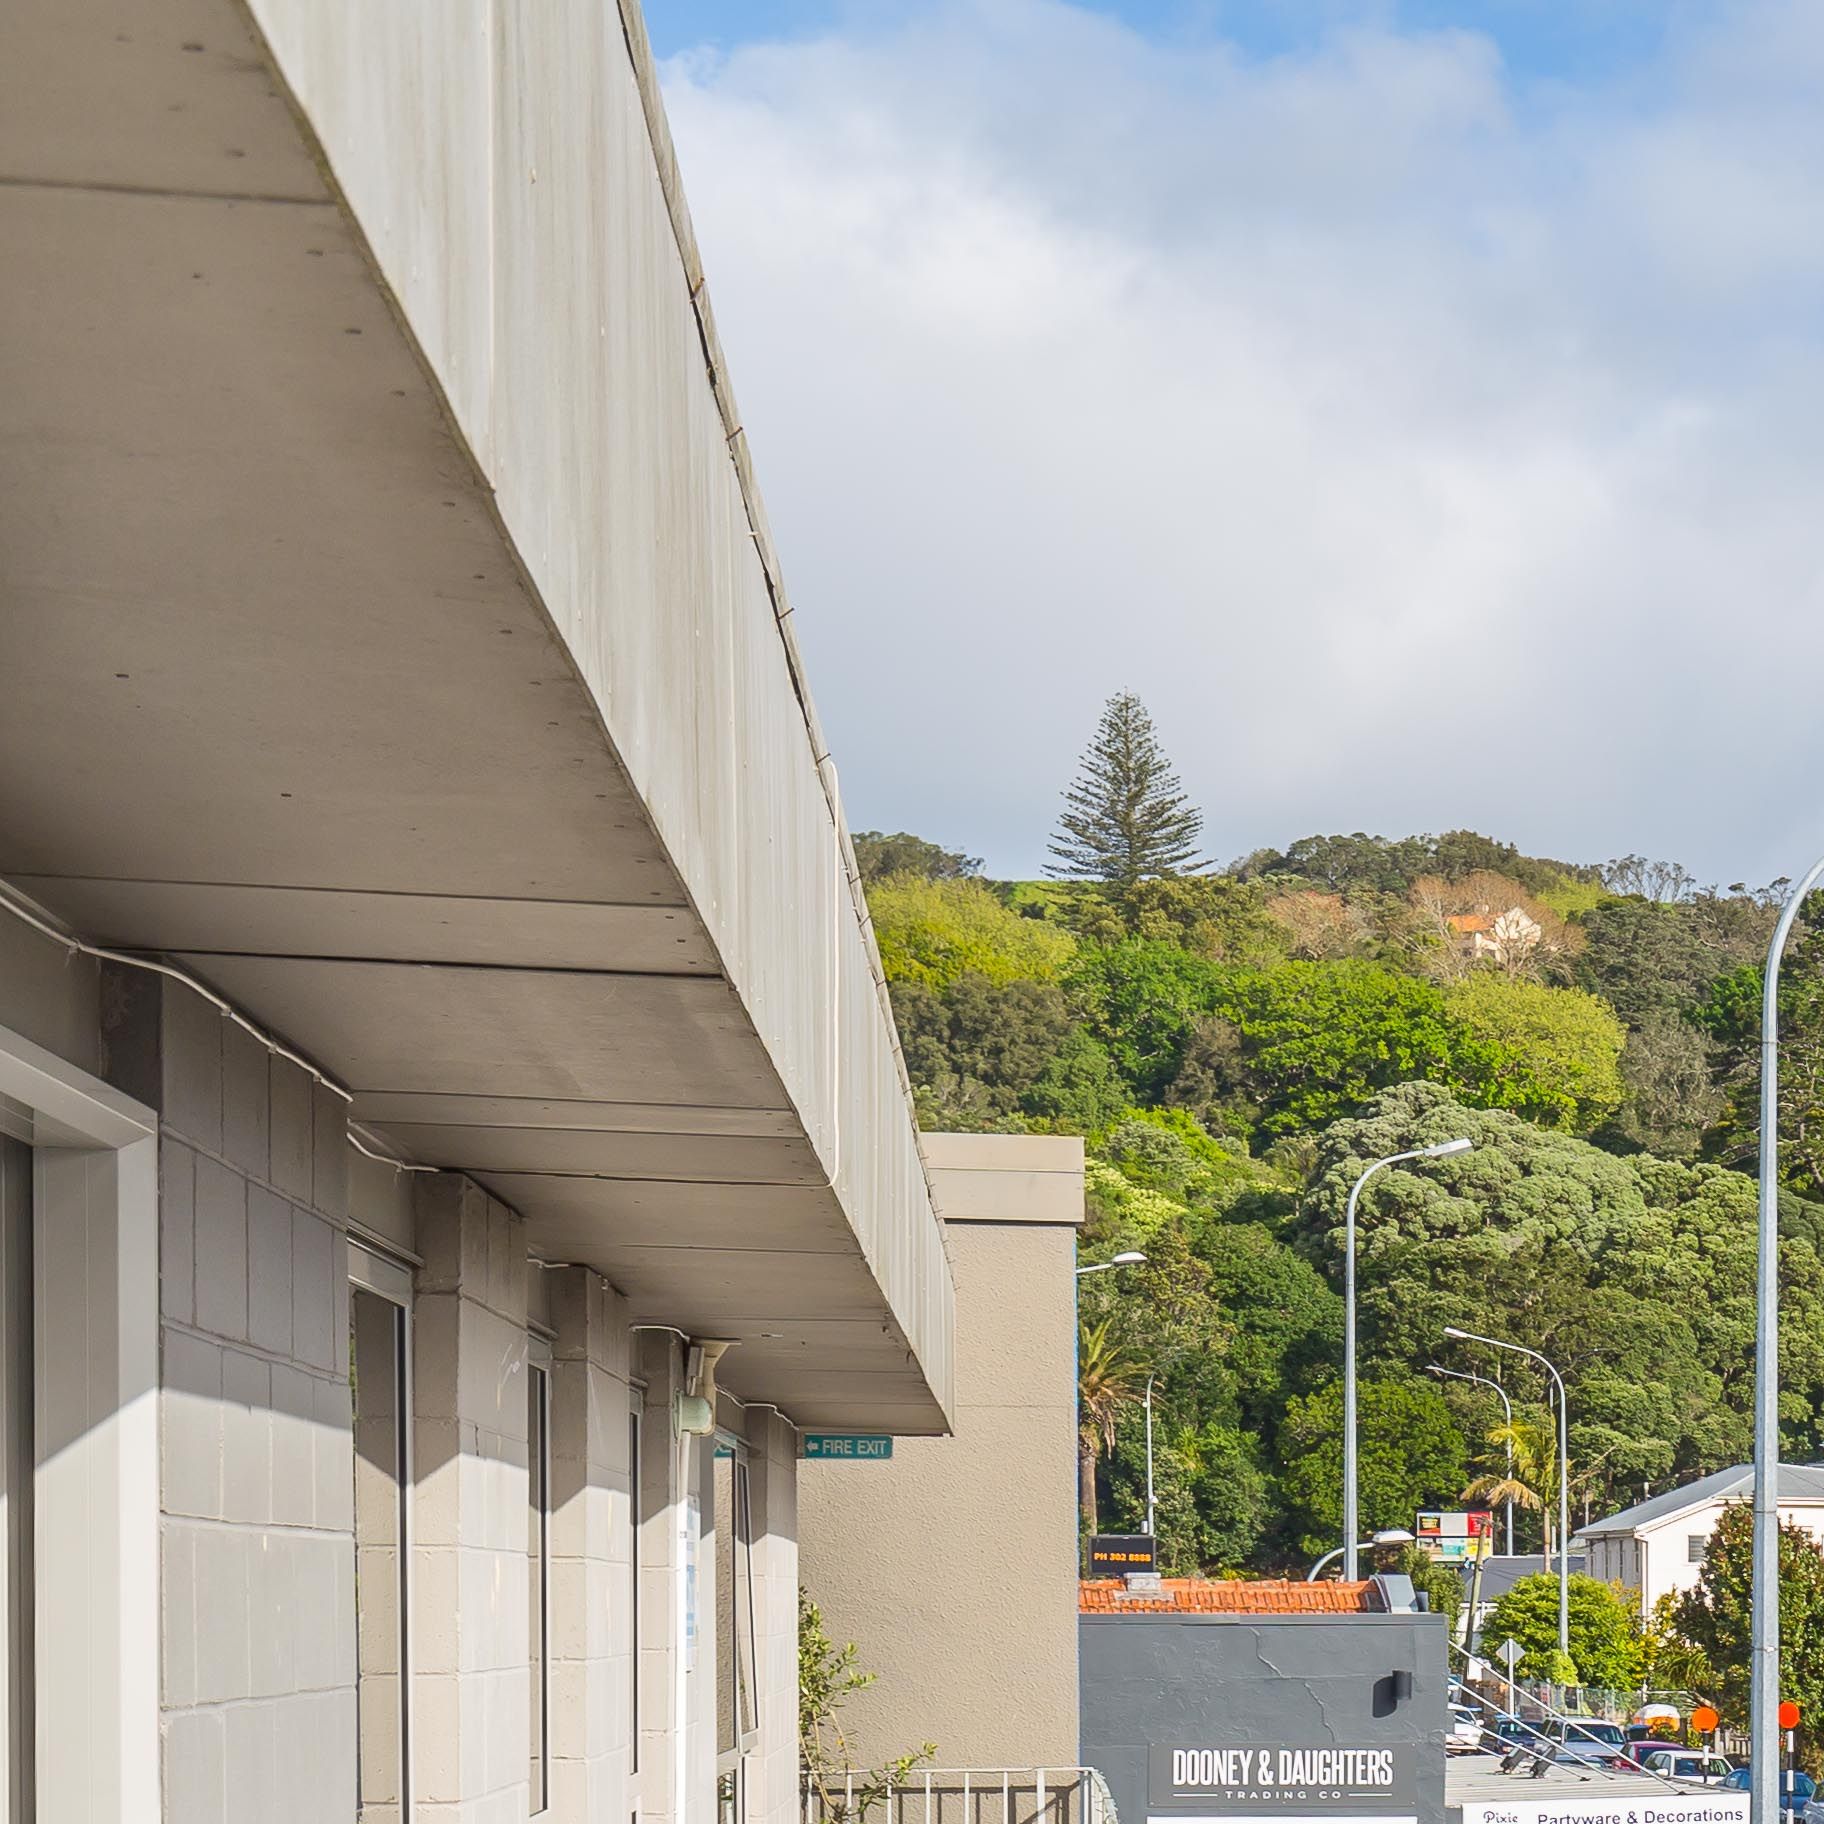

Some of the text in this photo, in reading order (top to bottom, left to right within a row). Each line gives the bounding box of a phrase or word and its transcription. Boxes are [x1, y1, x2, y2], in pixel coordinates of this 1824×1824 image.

[822, 1439, 886, 1455] FIRE EXIT
[1172, 1749, 1394, 1787] DOONEY & DAUGHTERS
[1225, 1790, 1342, 1800] TRADING CO
[1483, 1810, 1518, 1824] Pixie
[1626, 1810, 1639, 1824] &
[1644, 1808, 1744, 1824] Decorations
